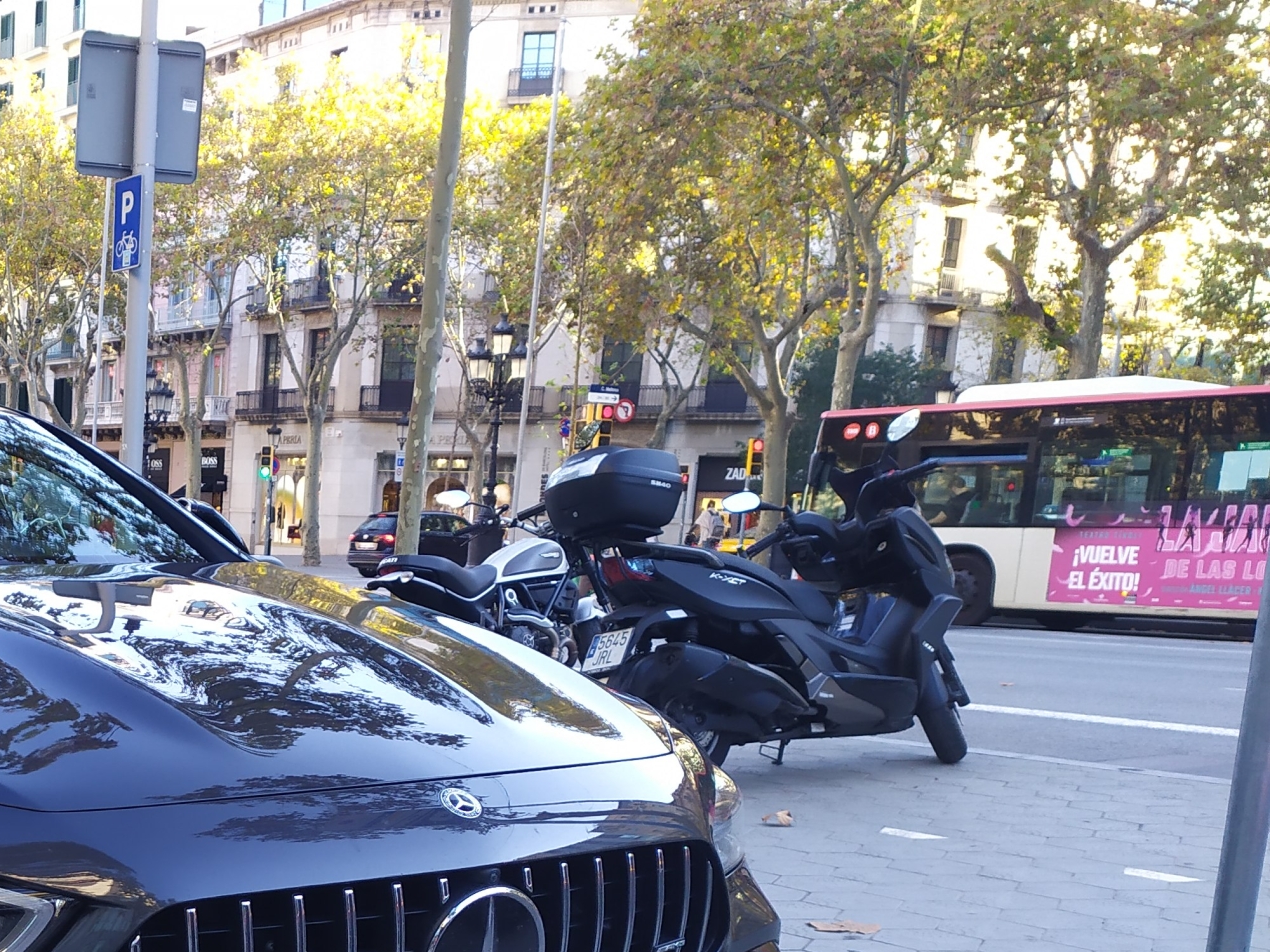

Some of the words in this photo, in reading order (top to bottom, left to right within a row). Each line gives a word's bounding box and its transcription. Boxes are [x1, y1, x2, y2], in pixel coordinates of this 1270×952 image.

[121, 190, 135, 225] P
[148, 458, 163, 468] OSS
[1072, 545, 1140, 567] ¡VUELVE
[1067, 570, 1086, 590] EL
[1088, 567, 1140, 592] ÉXITO!
[1164, 559, 1191, 578] DE
[1196, 559, 1236, 580] LAS
[598, 631, 629, 650] 5645
[592, 649, 612, 666] JRL
